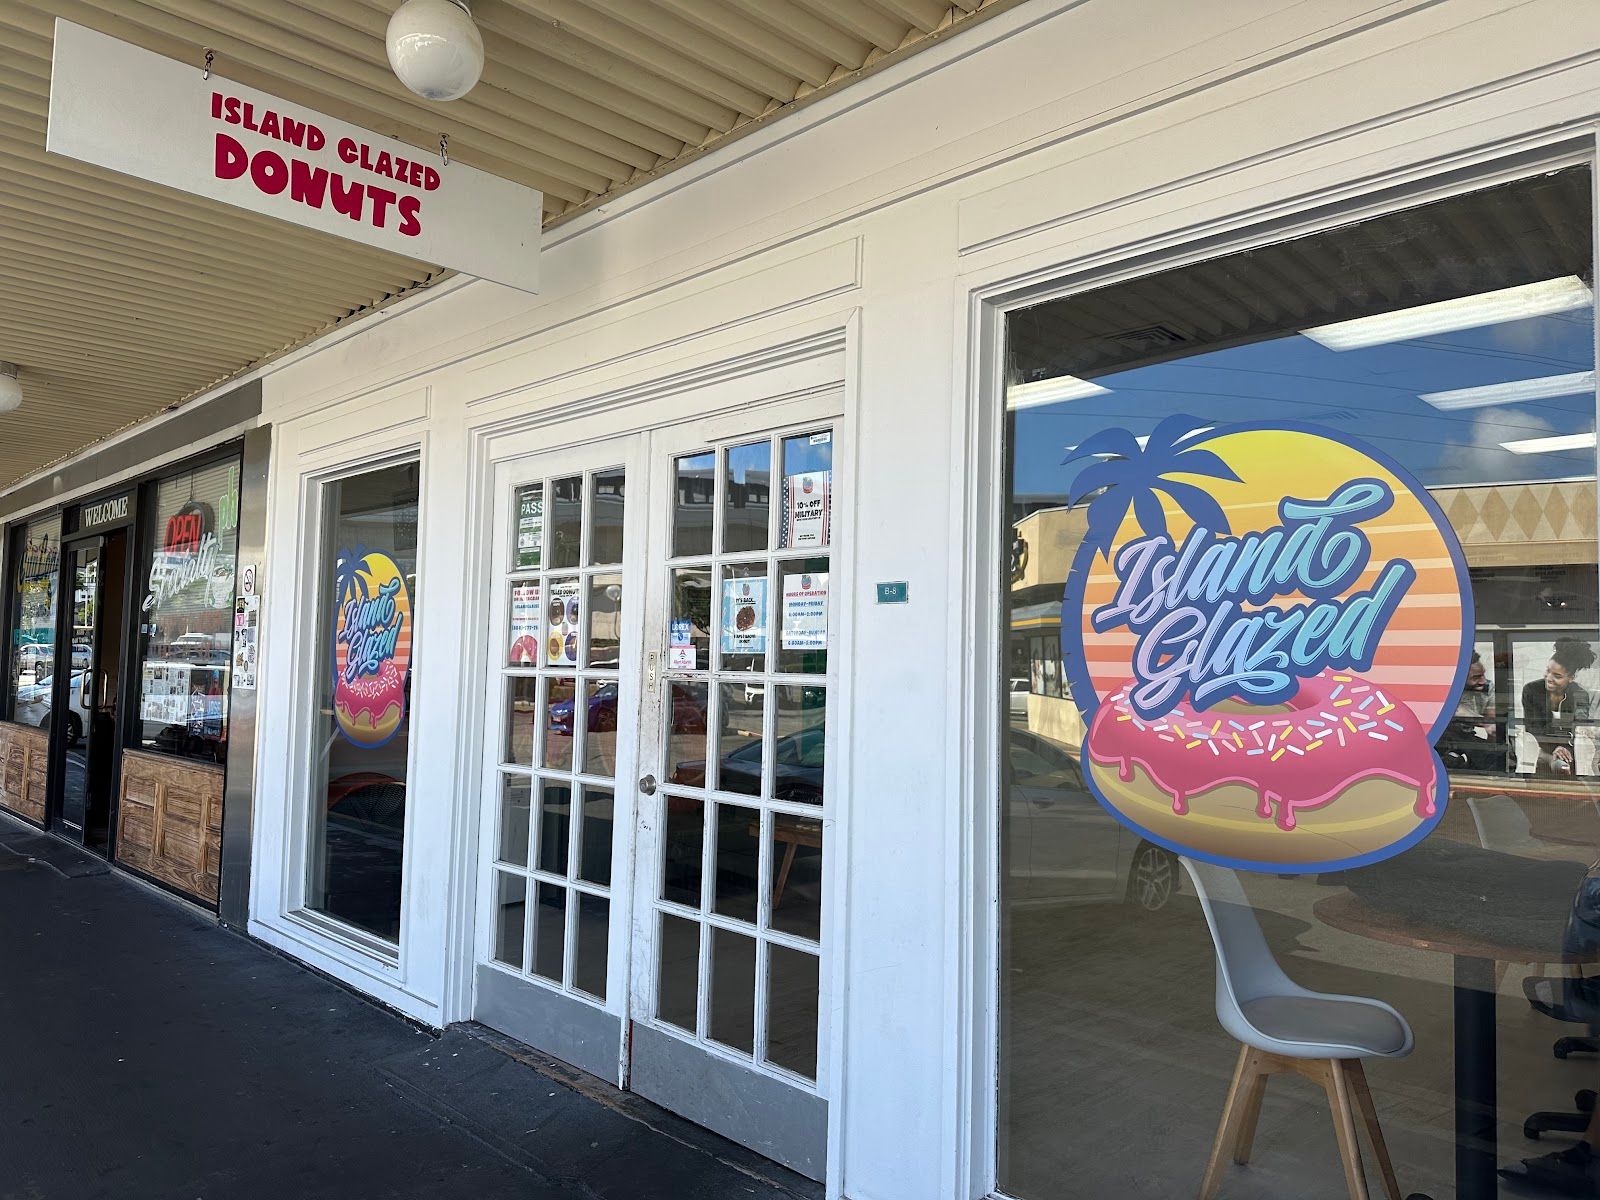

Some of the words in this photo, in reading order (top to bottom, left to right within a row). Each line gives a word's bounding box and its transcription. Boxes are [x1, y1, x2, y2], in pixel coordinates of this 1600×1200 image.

[211, 92, 325, 152] ISLAND
[338, 137, 441, 191] GLAZED
[215, 133, 422, 237] DONUTS
[85, 496, 129, 527] WELCOME
[521, 501, 543, 516] PASS
[795, 509, 823, 519] MILITARY
[810, 499, 821, 507] OFF
[163, 513, 203, 556] OPEN
[1096, 484, 1385, 624] Island
[339, 577, 400, 641] Island
[884, 587, 897, 595] B-8
[346, 612, 404, 683] Glazed
[1132, 563, 1406, 711] Glazed
